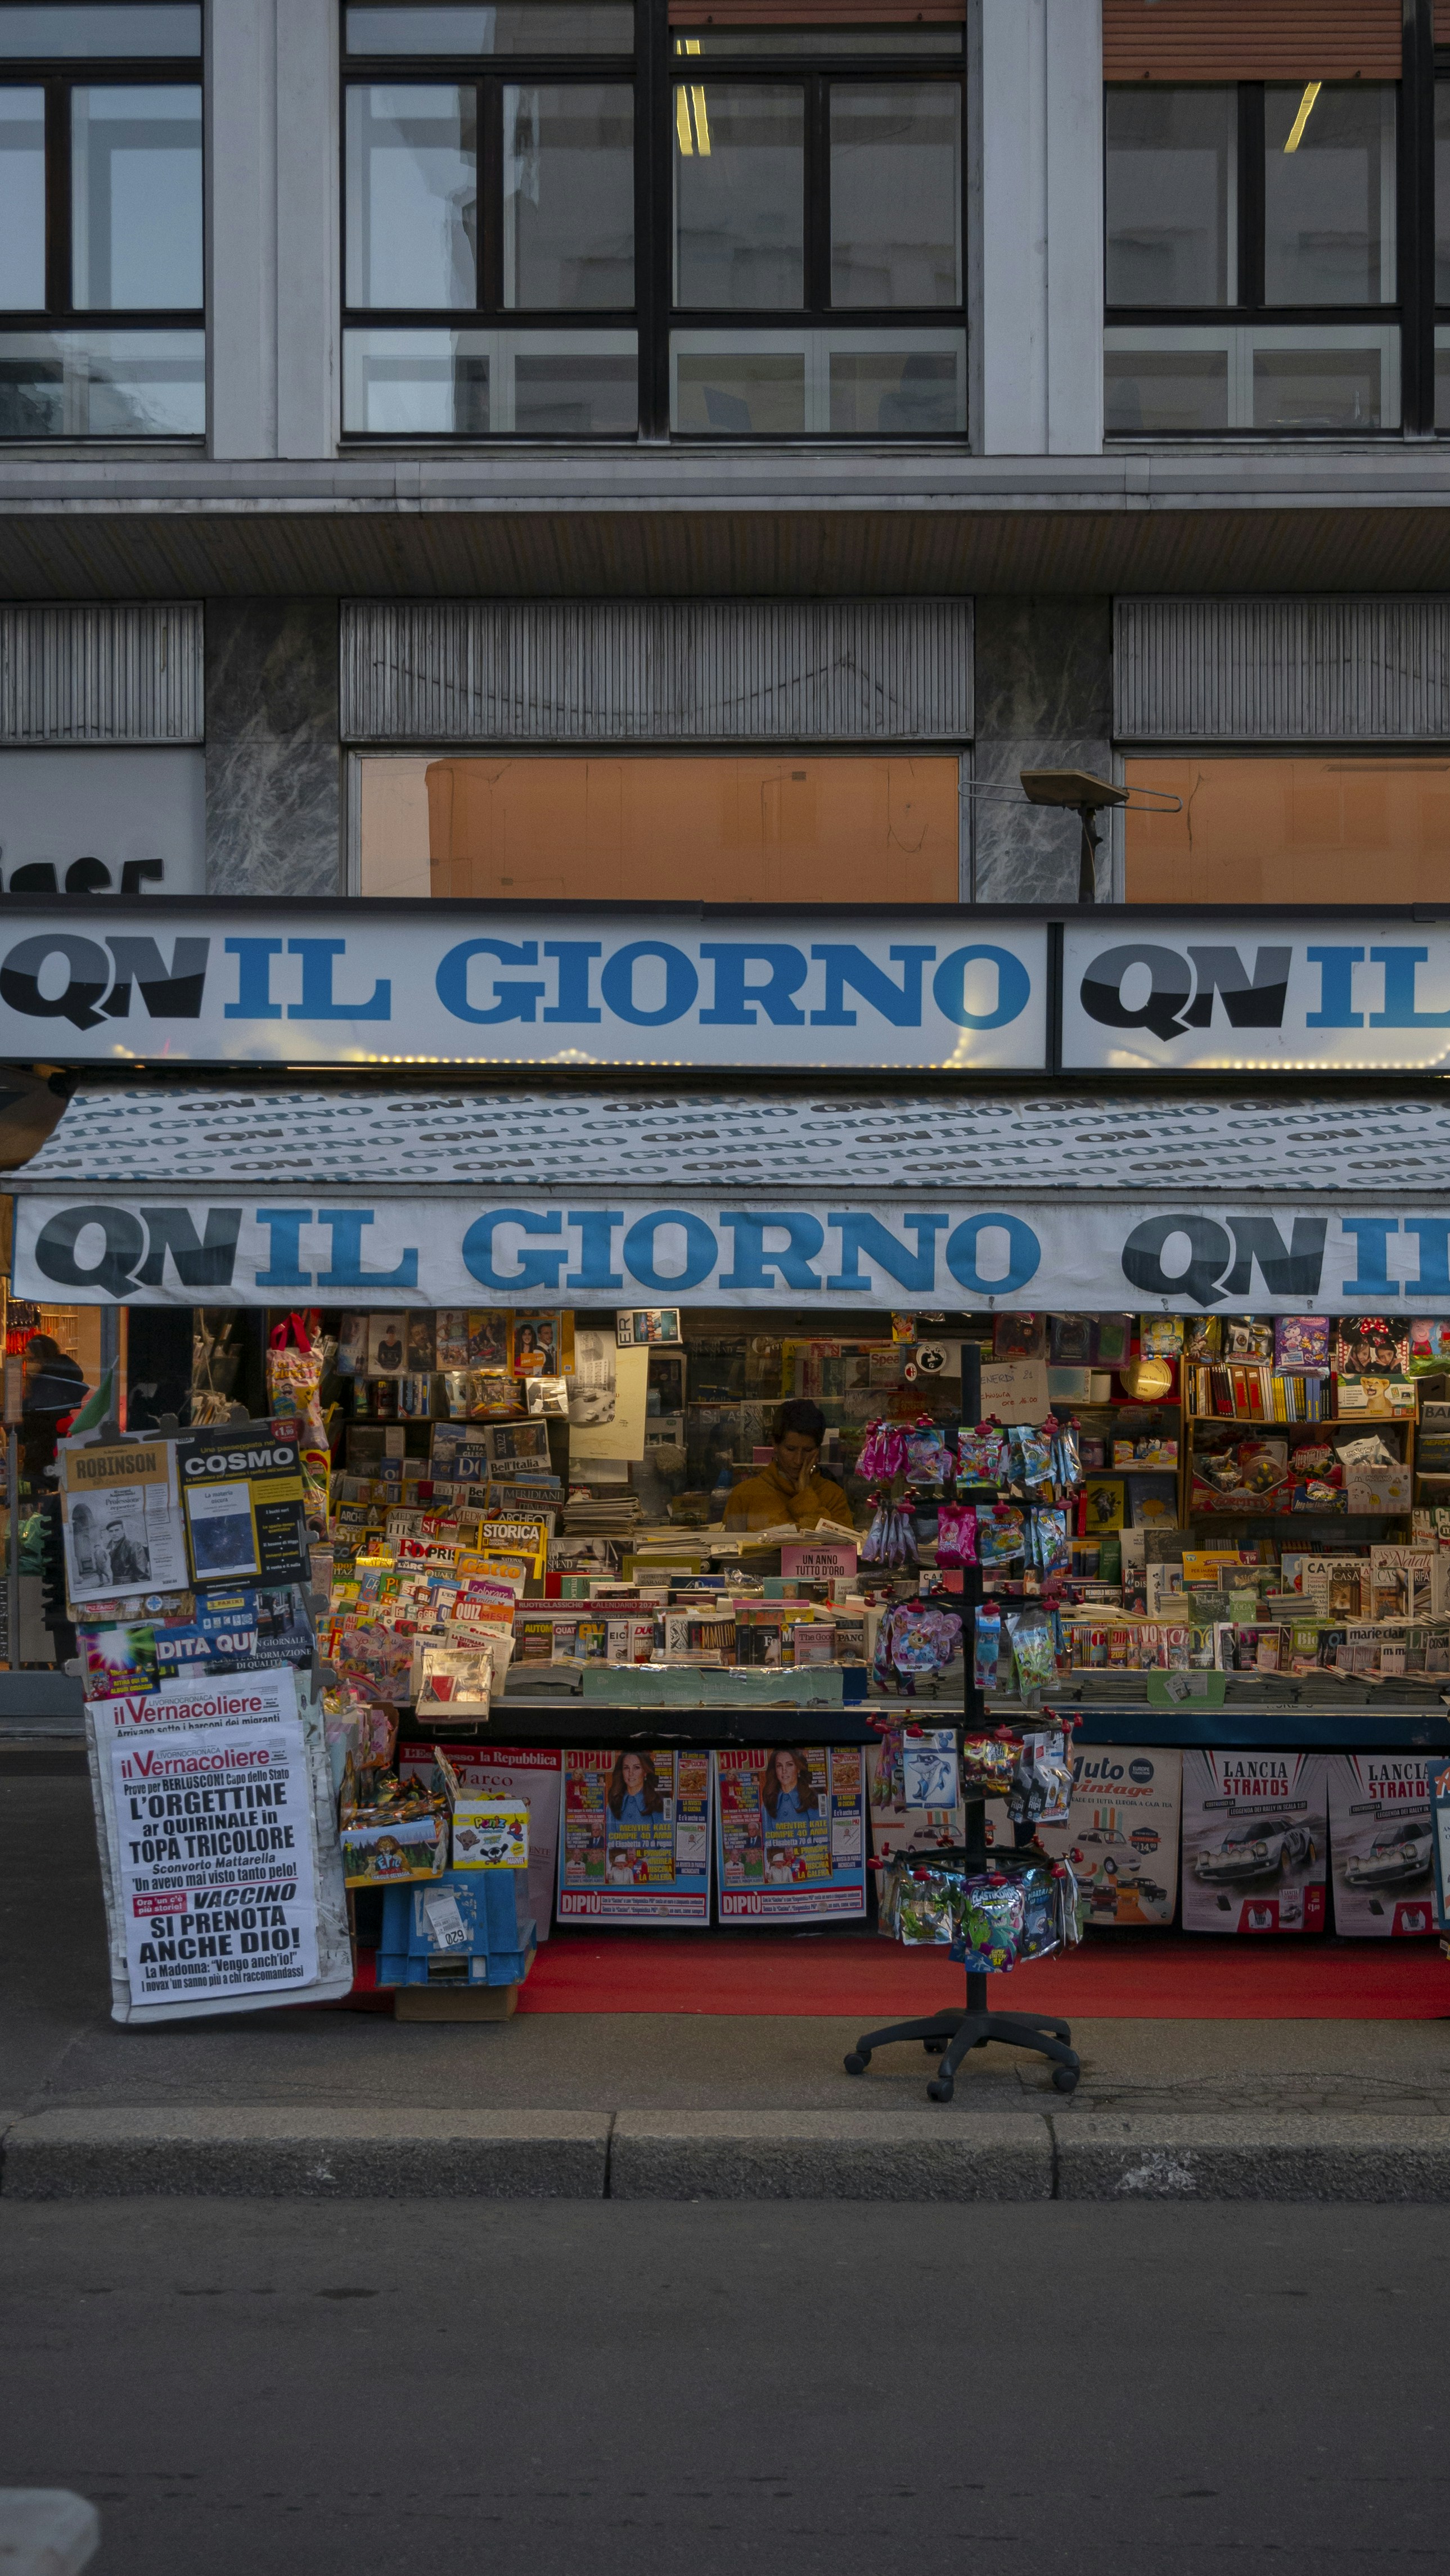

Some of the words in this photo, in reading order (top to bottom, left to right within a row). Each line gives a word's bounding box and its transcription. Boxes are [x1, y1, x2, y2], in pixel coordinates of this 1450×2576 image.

[0, 933, 210, 1031] QN
[224, 938, 391, 1021] IL
[435, 939, 1030, 1030] GIORNO
[1080, 944, 1293, 1041] QN
[1307, 946, 1450, 1028] IL
[204, 1129, 283, 1142] QN
[287, 1125, 356, 1135] IL
[369, 1107, 589, 1130] GIORNO
[418, 1129, 498, 1142] QN
[501, 1125, 569, 1136] IL
[582, 1108, 798, 1130] GIORNO
[854, 1130, 933, 1143] QN
[931, 1127, 1001, 1138] IL
[1010, 1106, 1219, 1131] GIORNO
[230, 1158, 313, 1171] QN
[317, 1154, 388, 1165] IL
[401, 1136, 628, 1159] GIORNO
[35, 1206, 242, 1298] QN
[256, 1208, 418, 1288] IL
[462, 1208, 1041, 1295] GIORNO
[1122, 1213, 1328, 1307] QN
[217, 1442, 263, 1452] passeggiata
[76, 1452, 156, 1478] ROBINSON
[185, 1447, 294, 1474] COSMO
[491, 1459, 539, 1473] Bell'Italia
[506, 1490, 560, 1500] MERIDIANI
[483, 1524, 539, 1540] STORICA
[462, 1558, 521, 1578] Gatto
[796, 1566, 819, 1575] TUTTO
[822, 1566, 844, 1575] D'ORO
[803, 1555, 814, 1564] UN
[816, 1555, 837, 1564] ANNO
[1333, 1571, 1359, 1581] CASA
[456, 1603, 482, 1620] QUIZ
[483, 1613, 509, 1621] MESE
[1350, 1627, 1381, 1639] marie
[156, 1637, 211, 1659] DITA
[114, 1706, 125, 1725] il
[125, 1696, 262, 1724] Vernacoliere
[149, 1695, 214, 1706] LIVORNOCRONACA
[121, 1760, 133, 1778] il
[133, 1749, 269, 1776] Vernacoliere
[156, 1747, 220, 1760] LIVORNOCRONACA
[404, 1748, 475, 1762] L'Esesso
[480, 1751, 490, 1762] la
[494, 1752, 557, 1766] Repubblica
[1223, 1761, 1288, 1778] LANCIA
[124, 1783, 146, 1795] Prove
[147, 1782, 161, 1794] per
[163, 1773, 224, 1792] BERLUSCONI
[227, 1773, 246, 1786] Capo
[247, 1771, 267, 1783] dello
[269, 1769, 289, 1780] Stato
[1072, 1779, 1154, 1798] vintage
[1223, 1779, 1288, 1795] STRATOS
[130, 1782, 287, 1820] L'ORGETTINE
[1029, 1801, 1041, 1811] RIP!
[143, 1824, 159, 1837] ar
[163, 1811, 259, 1836] QUIRINALE
[262, 1810, 278, 1824] in
[129, 1837, 181, 1864] TOPA
[184, 1825, 295, 1858] TRICOLORE
[151, 1876, 183, 1889] avevo
[186, 1872, 206, 1886] mai
[209, 1870, 235, 1883] visto
[237, 1866, 266, 1881] tanto
[269, 1862, 297, 1880] pelo!
[152, 1860, 211, 1875] Sconvorto
[215, 1853, 276, 1869] Mattarella
[170, 1895, 183, 1903] c'è
[194, 1883, 297, 1910] VACCINO
[563, 1890, 601, 1914] DIPIÙ
[723, 1891, 762, 1914] DIPIÙ
[138, 1905, 152, 1914] più
[154, 1903, 182, 1912] storie!
[150, 1916, 174, 1938] SI
[181, 1905, 286, 1936] PRENOTA
[139, 1934, 233, 1964] ANCHE
[240, 1927, 300, 1954] DIO!
[146, 1965, 157, 1979] La
[159, 1961, 210, 1975] Madonna:
[146, 1979, 169, 1991] novax
[183, 1975, 208, 1987] sanno
[209, 1973, 222, 1987] più
[229, 1971, 242, 1983] chi
[243, 1965, 304, 1982] raccomandassi
